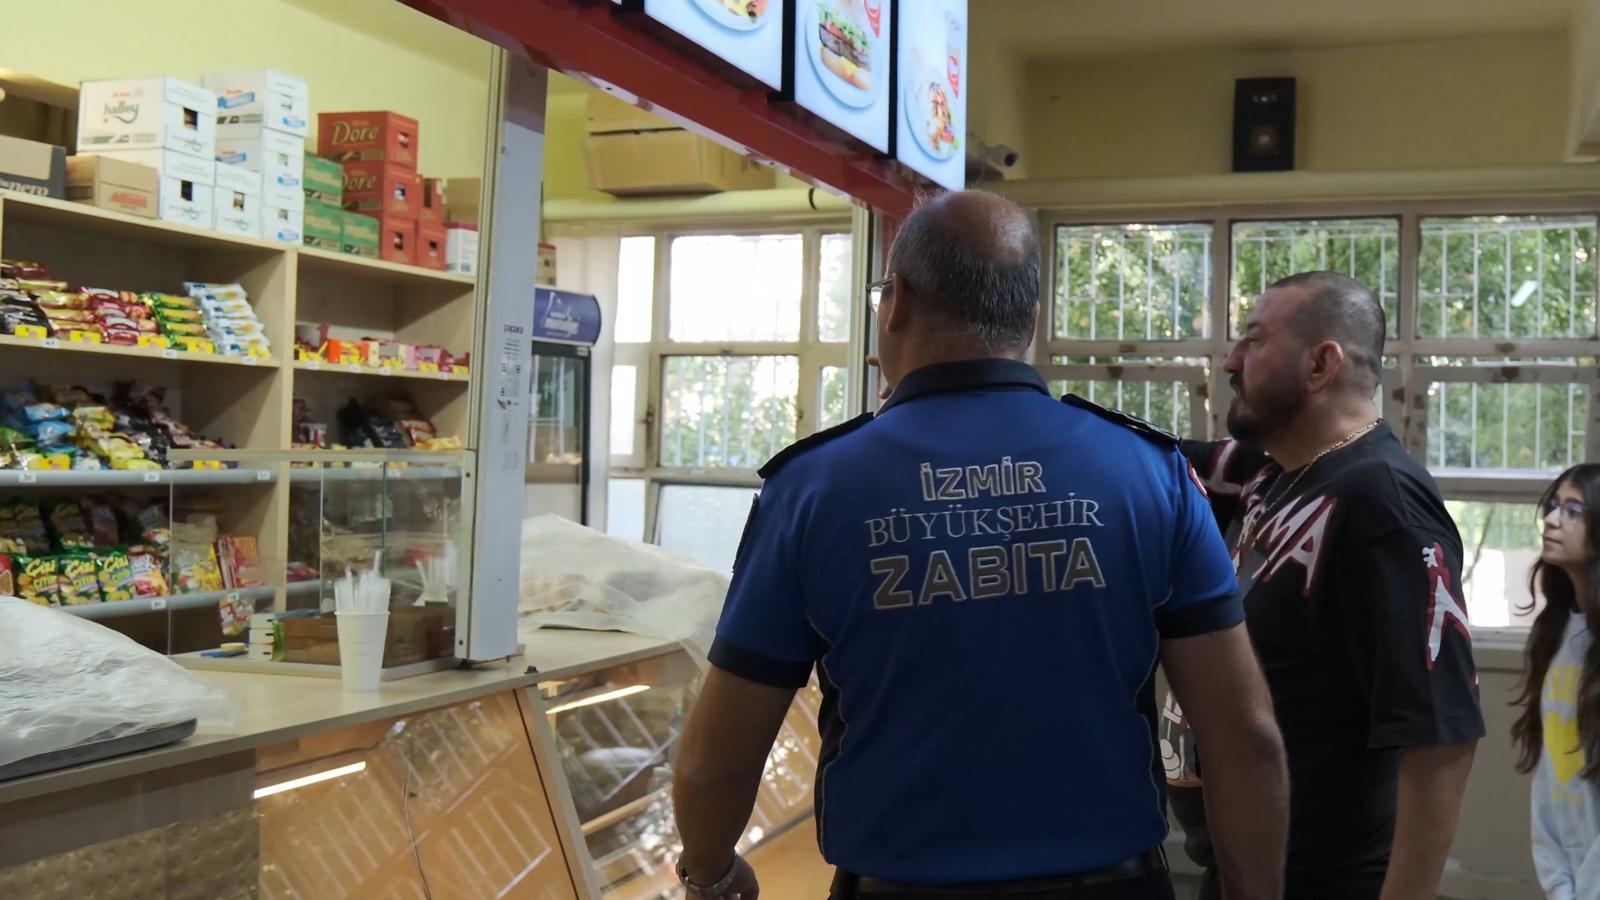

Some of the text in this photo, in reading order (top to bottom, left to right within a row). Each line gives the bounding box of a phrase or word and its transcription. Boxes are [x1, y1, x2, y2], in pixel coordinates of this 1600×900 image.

[103, 101, 139, 123] halley
[331, 121, 379, 145] Dore
[920, 456, 1047, 501] İZMİR
[864, 492, 1105, 547] BÜYÜKŞEHİR
[870, 537, 1106, 610] ZABITA
